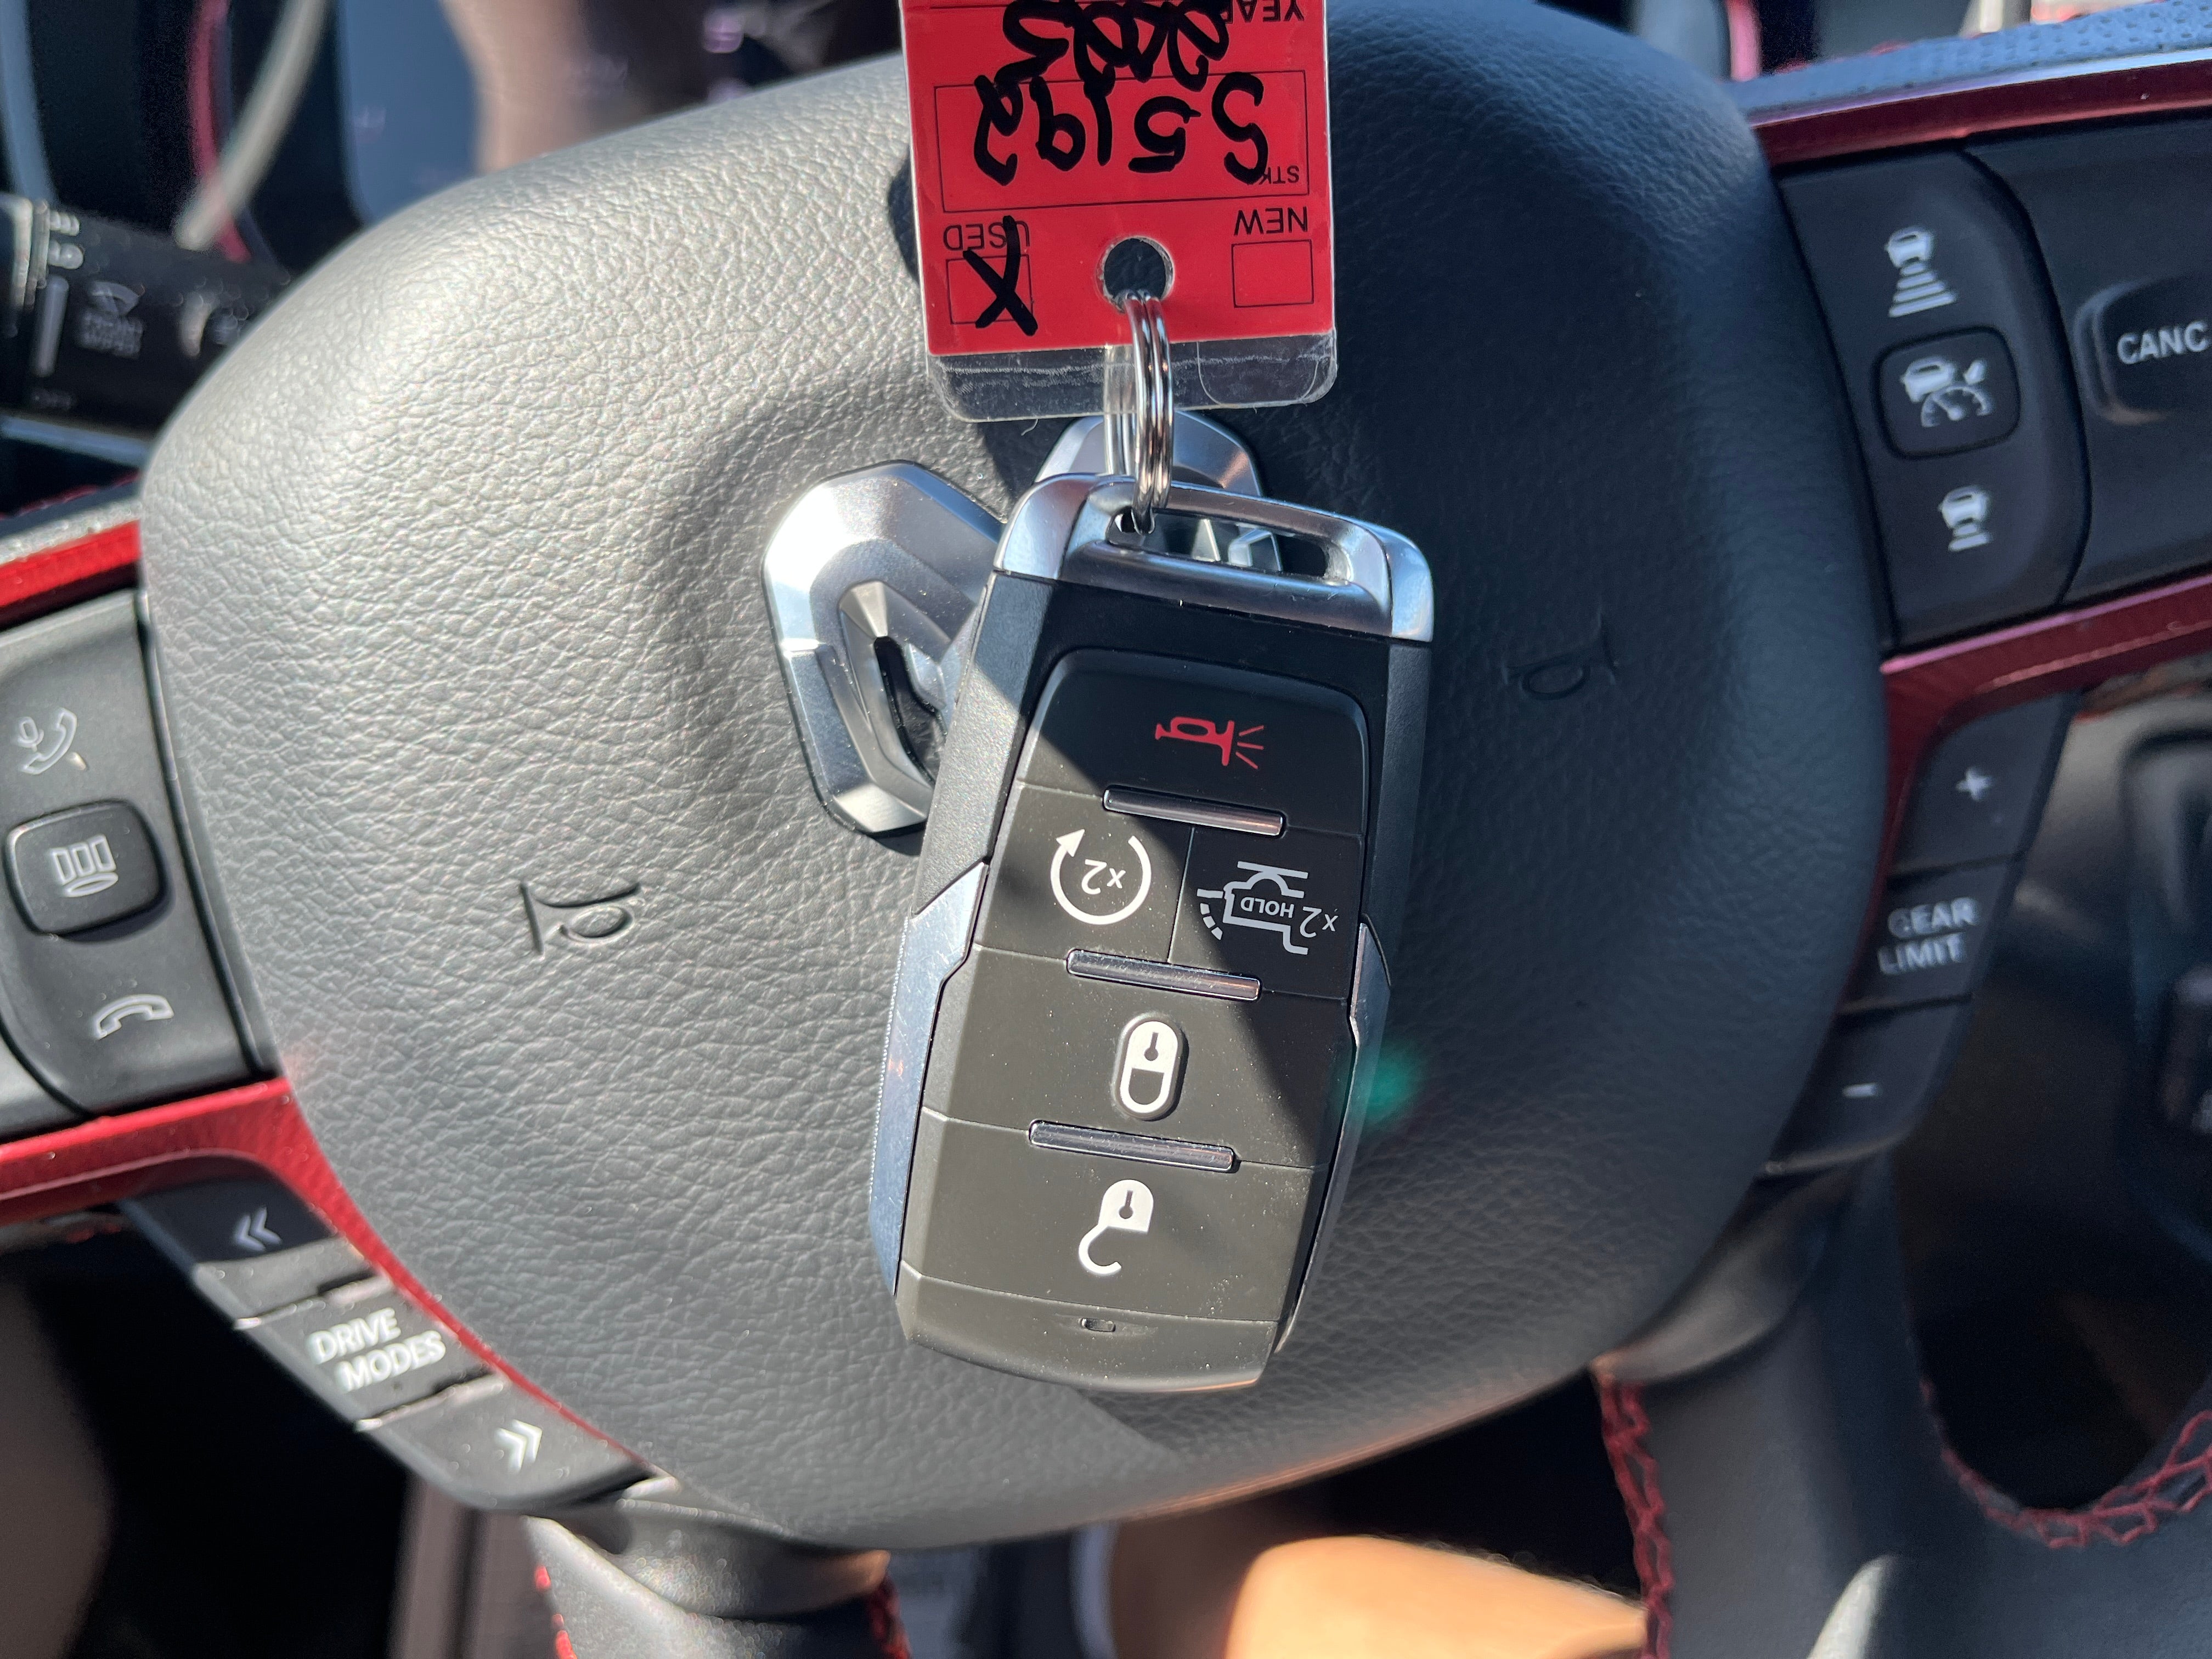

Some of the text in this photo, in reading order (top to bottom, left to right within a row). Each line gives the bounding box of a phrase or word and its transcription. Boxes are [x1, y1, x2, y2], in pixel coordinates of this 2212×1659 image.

[1234, 206, 1308, 236] NEW
[2117, 320, 2211, 364] CANC
[1082, 859, 1126, 895] x2
[1240, 896, 1295, 920] HOLD
[1300, 907, 1338, 938] x2
[1888, 896, 1977, 939] GEAR
[1877, 933, 1968, 975] LIMIT
[307, 1307, 401, 1364] DRIVE
[335, 1330, 446, 1393] MODES
